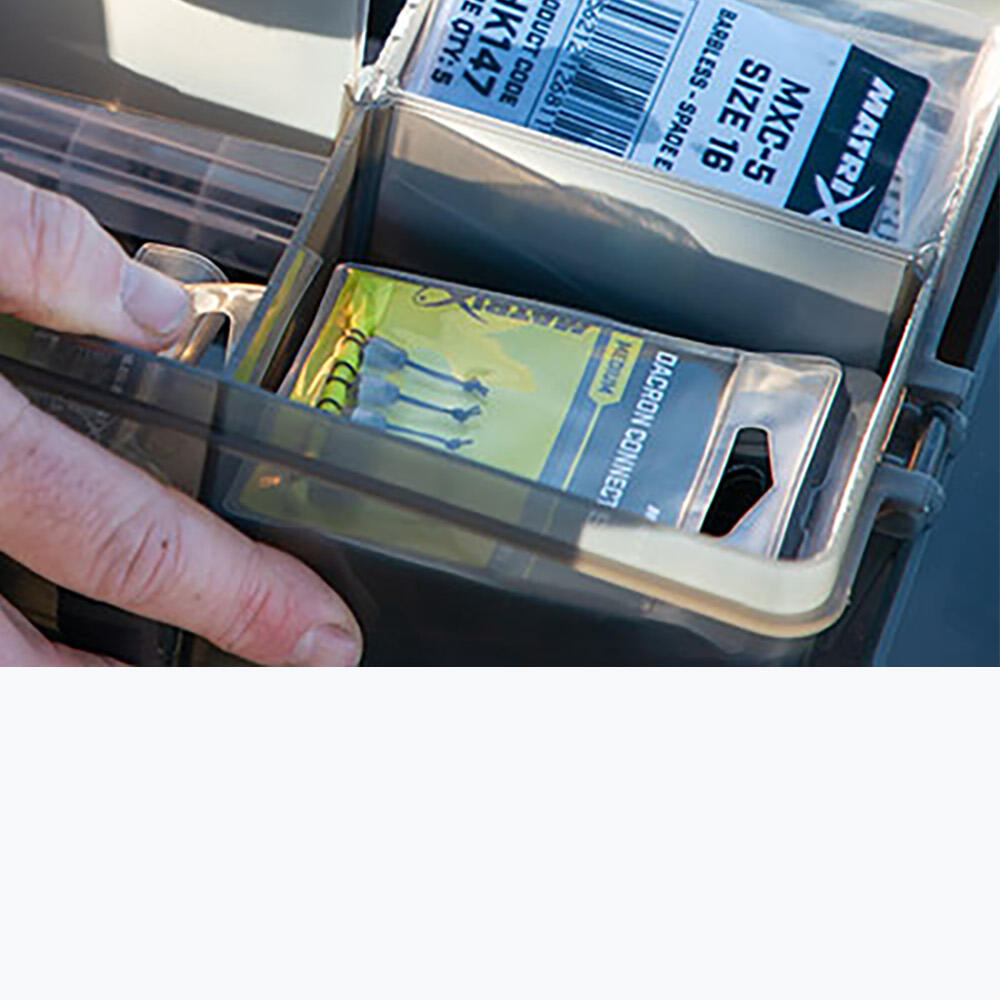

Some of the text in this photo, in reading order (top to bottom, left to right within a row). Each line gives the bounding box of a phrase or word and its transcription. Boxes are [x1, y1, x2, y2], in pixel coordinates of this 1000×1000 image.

[500, 57, 534, 106] CODE
[689, 8, 738, 90] BARBLESS
[659, 101, 697, 157] SPADE
[700, 59, 772, 172] SIZE 16
[743, 78, 810, 185] MXC-5
[598, 340, 633, 396] MEDIUM
[631, 351, 679, 427] DACRON
